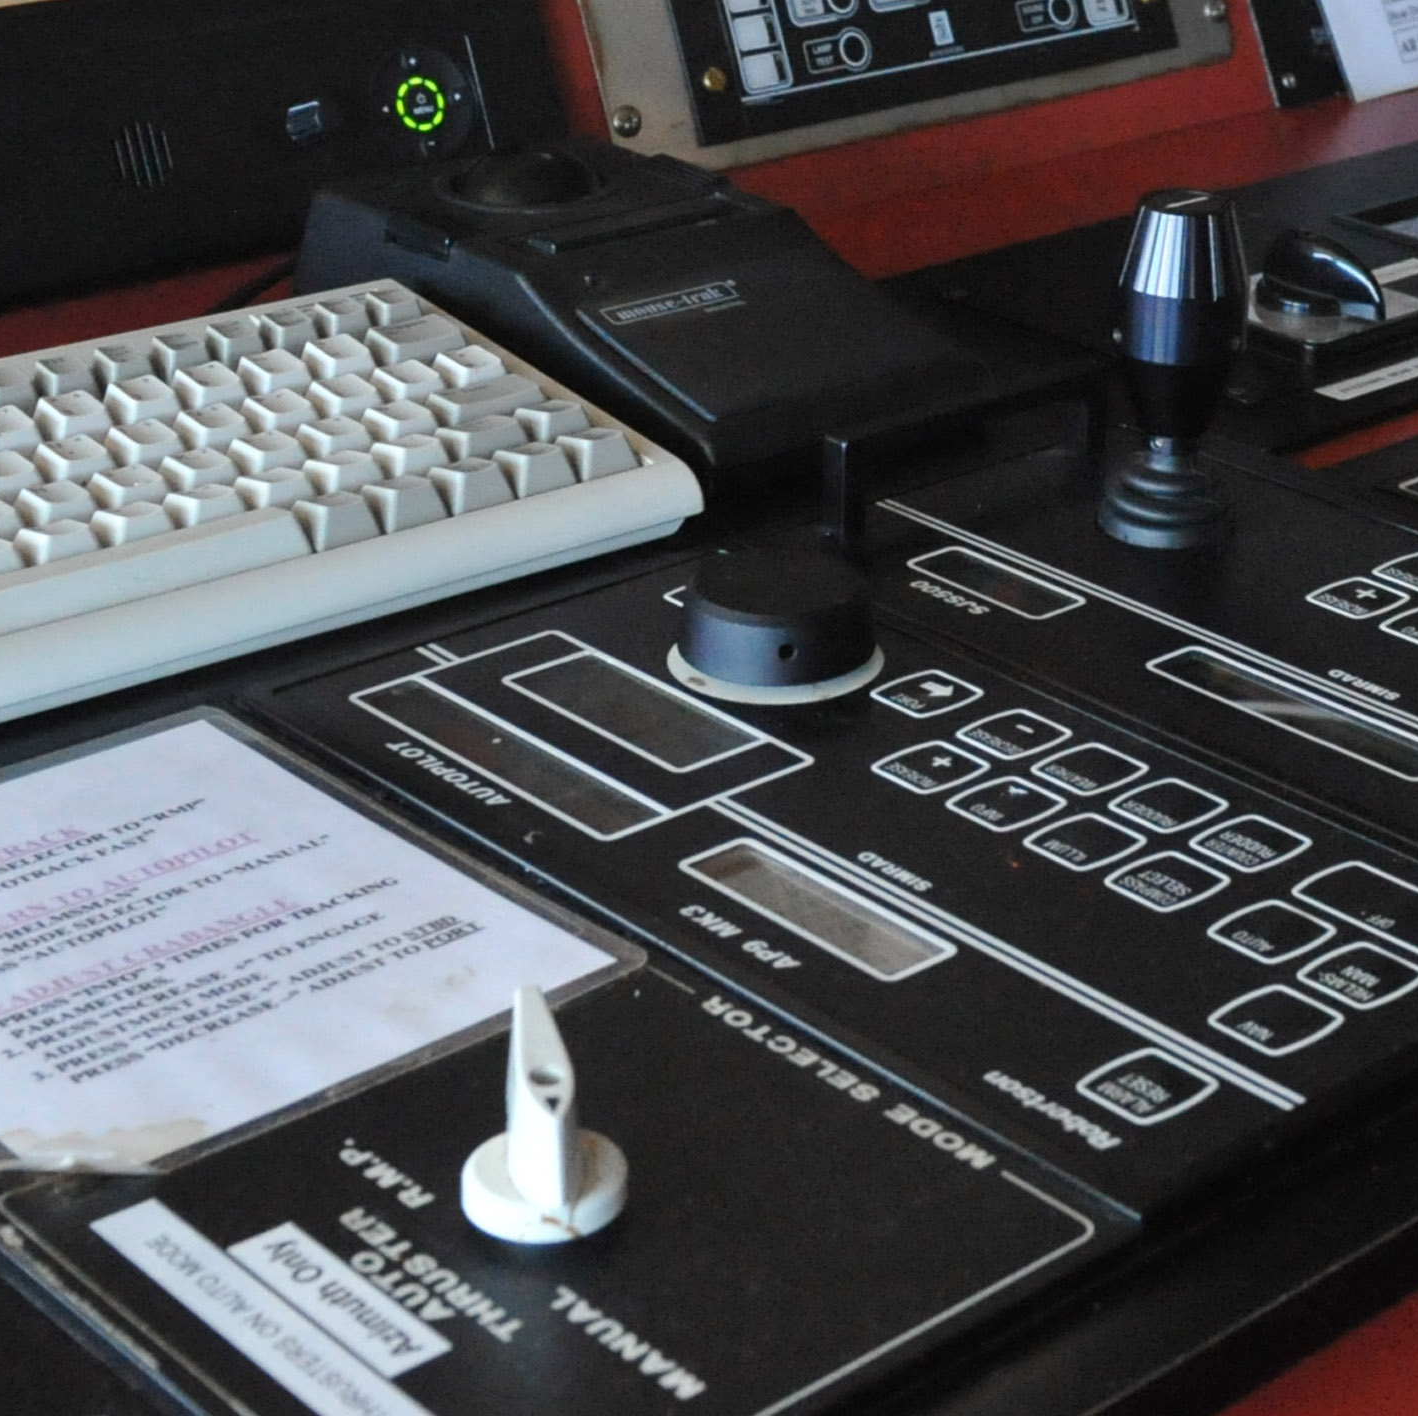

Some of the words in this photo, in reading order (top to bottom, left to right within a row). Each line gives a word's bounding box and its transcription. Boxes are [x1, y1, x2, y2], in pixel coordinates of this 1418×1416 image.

[1327, 668, 1402, 702] SIMRAD
[386, 739, 513, 808] AUTOPILOT
[109, 820, 142, 835] TO
[968, 802, 1005, 822] INFO
[102, 830, 262, 887] AUTOPILOT
[856, 850, 933, 894] SIMRAD
[1, 926, 73, 956] MODE
[72, 885, 189, 930] SELECTOR
[191, 872, 223, 889] TO
[172, 936, 240, 965] TIMES
[239, 917, 287, 939] FOR
[289, 876, 400, 922] TRACKING
[259, 945, 293, 962] TO
[295, 911, 386, 949] ENGAGE
[679, 903, 744, 942] MK3
[1231, 930, 1276, 955] AUTO
[288, 949, 368, 985] ADJUST
[369, 936, 402, 952] TO
[401, 914, 463, 942] STBD
[307, 957, 388, 995] ADJUST
[389, 943, 422, 961] TO
[422, 921, 486, 950] PORT
[743, 935, 803, 972] AP9
[699, 992, 882, 1104] SELECTOR
[1236, 1020, 1276, 1043] NAV
[882, 1101, 998, 1172] MODE
[981, 1068, 1124, 1152] Robertson
[338, 1136, 436, 1211] R.M.P.
[195, 1269, 252, 1313] AUTO
[261, 1235, 326, 1286] Only
[338, 1205, 525, 1344] THRUSTER
[350, 1248, 457, 1325] AUTO
[245, 1310, 286, 1343] ON
[317, 1276, 429, 1360] Azimuth
[549, 1283, 708, 1402] MANUAL
